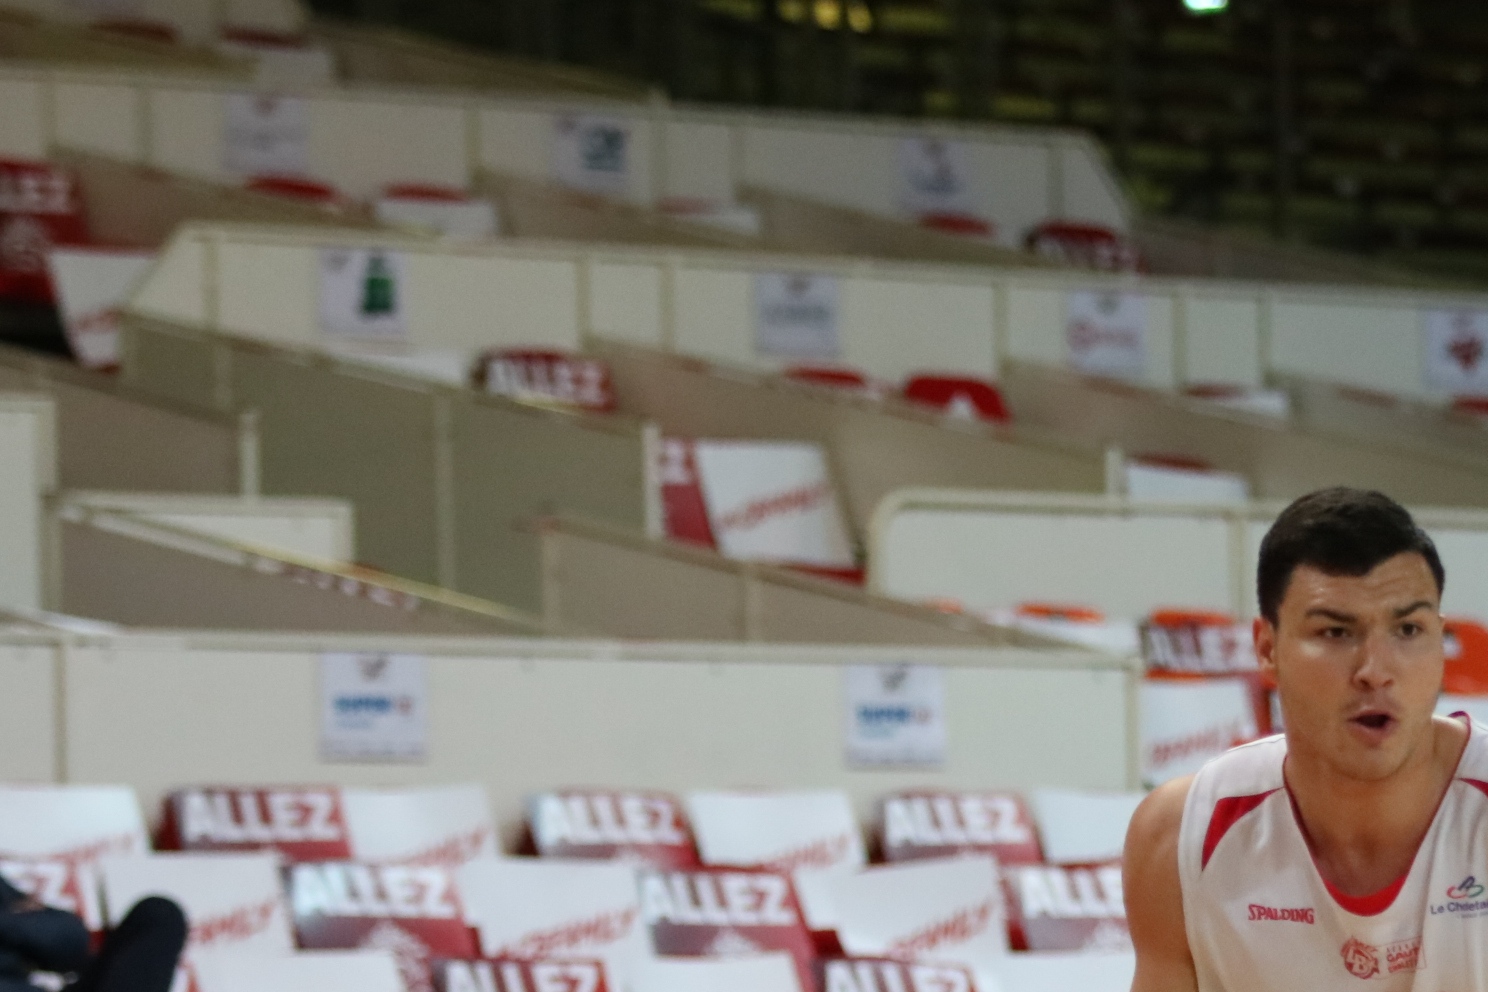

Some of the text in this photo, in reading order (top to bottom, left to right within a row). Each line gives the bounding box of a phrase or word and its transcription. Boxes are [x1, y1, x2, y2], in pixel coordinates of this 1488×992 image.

[184, 789, 340, 843] ALLEZ
[538, 795, 688, 846] ALLEZ
[885, 798, 1031, 846] ALLEZ
[293, 865, 450, 917] ALLEZ
[645, 870, 800, 925] ALLEZ
[1248, 904, 1314, 925] SPALDING
